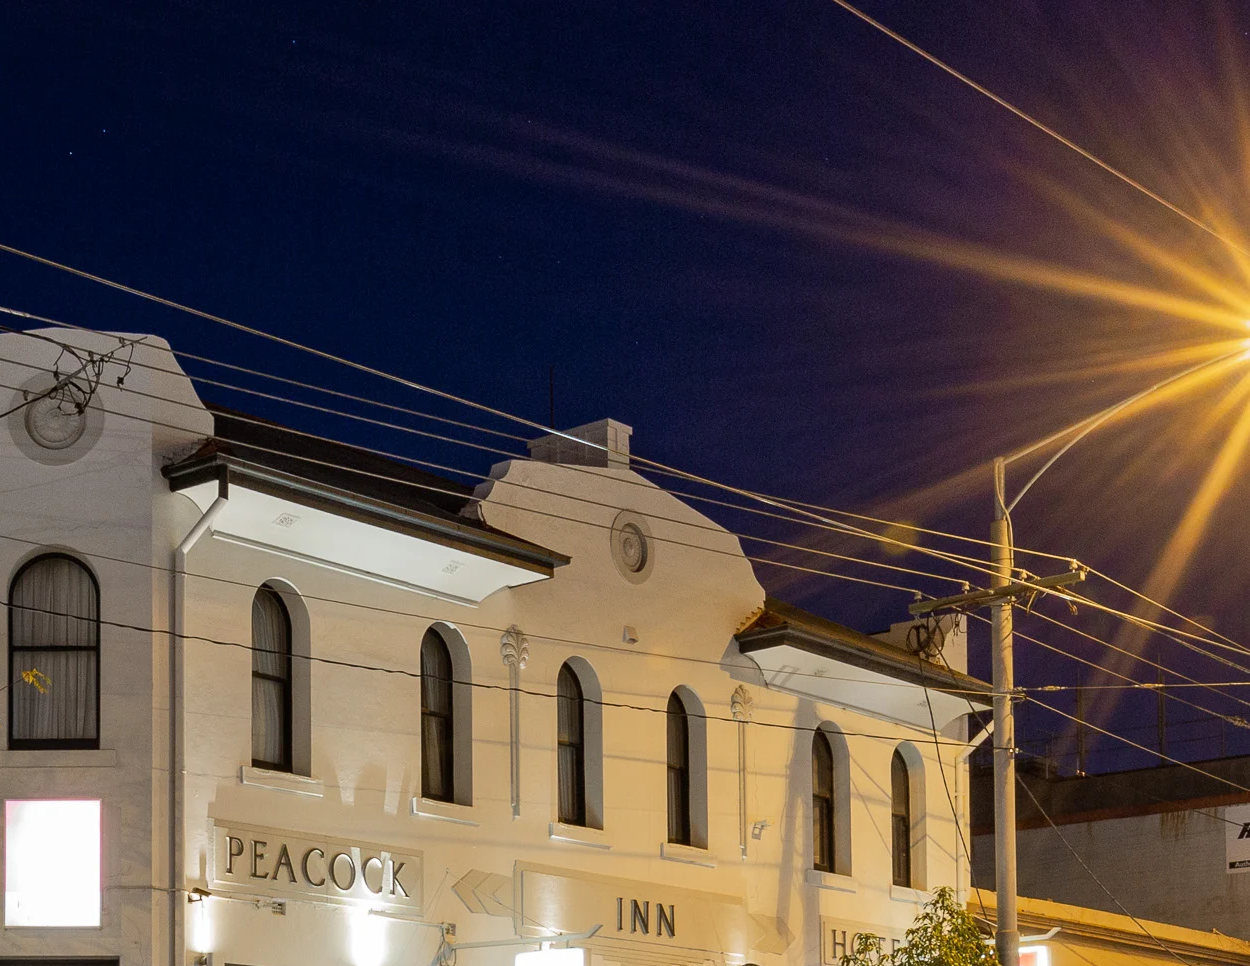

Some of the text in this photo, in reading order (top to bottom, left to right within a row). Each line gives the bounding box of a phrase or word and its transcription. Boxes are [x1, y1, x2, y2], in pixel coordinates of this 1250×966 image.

[225, 836, 410, 898] PEACOCK
[616, 897, 676, 939] INN
[831, 929, 914, 966] HOTE
